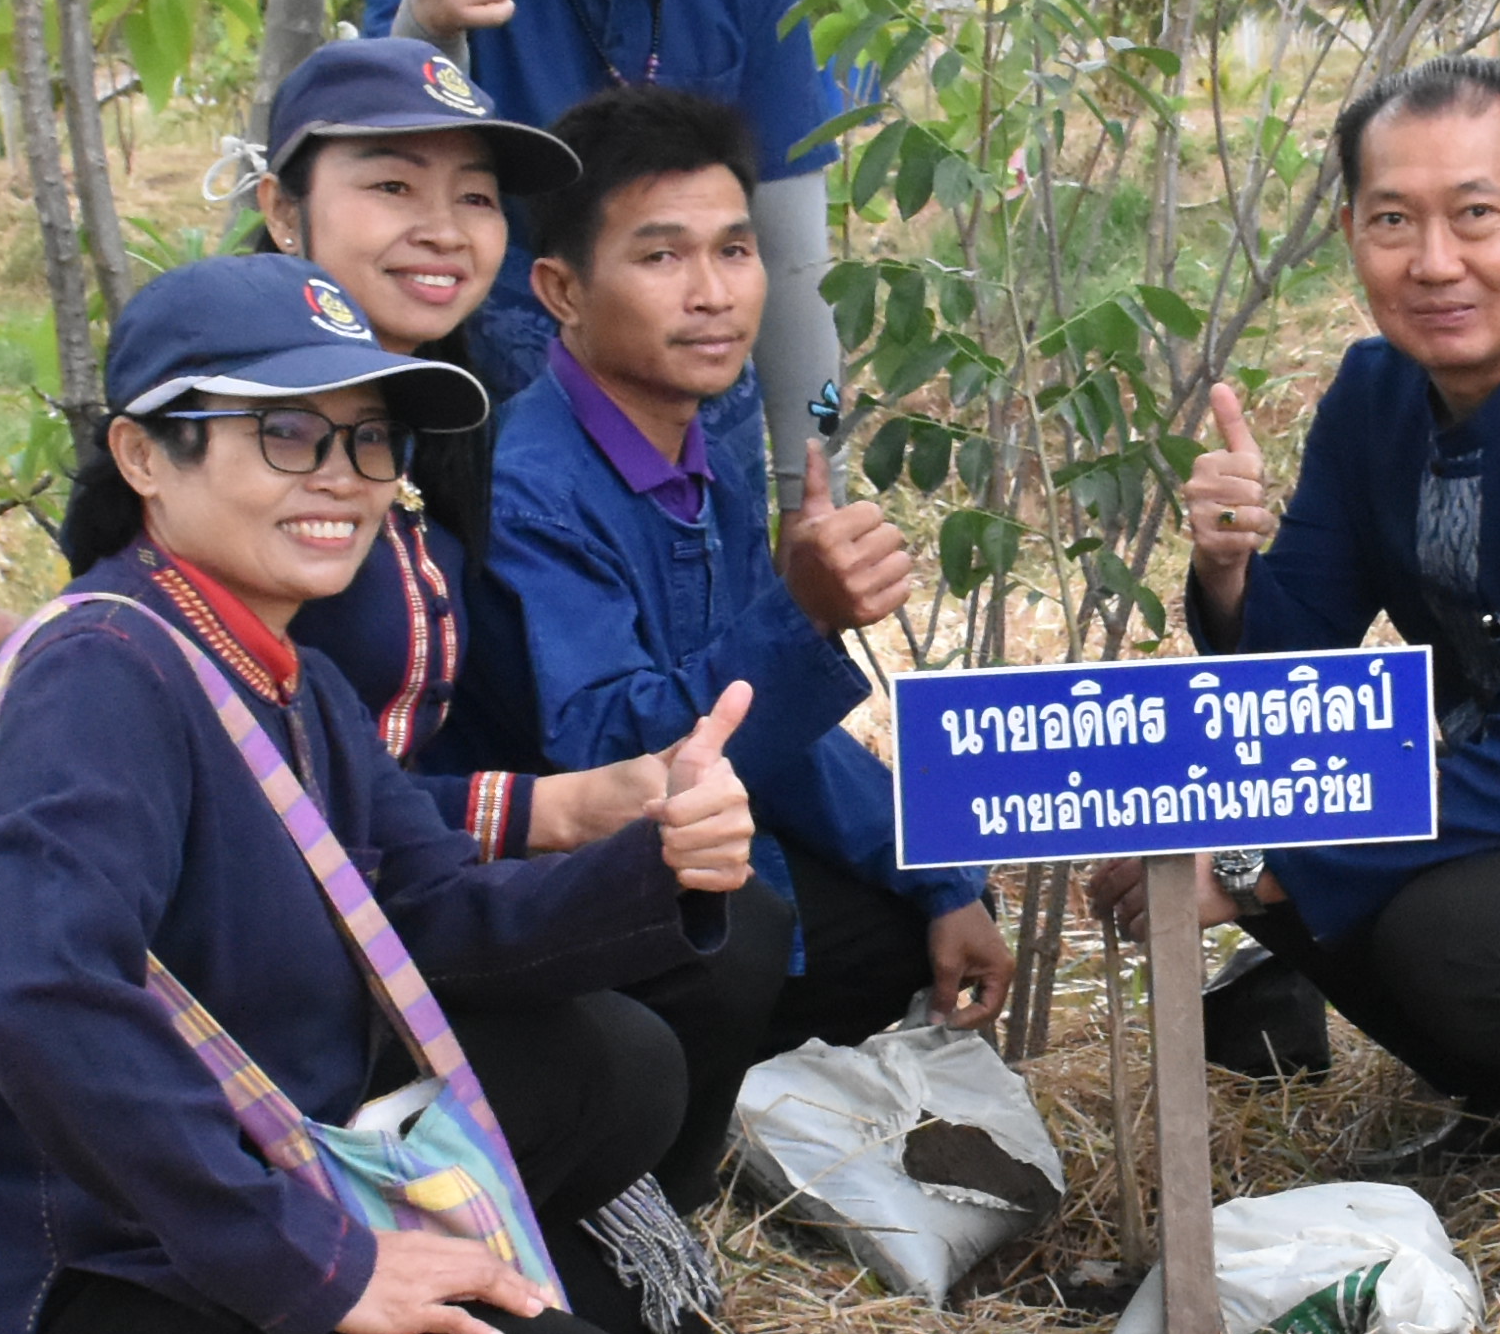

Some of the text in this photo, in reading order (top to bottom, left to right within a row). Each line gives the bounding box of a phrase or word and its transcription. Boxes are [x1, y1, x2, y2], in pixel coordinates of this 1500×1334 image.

[941, 658, 1394, 766] นายอดิศร วิทูรศิลป์
[971, 755, 1373, 836] นายอำเภอกันทรวิชัย
